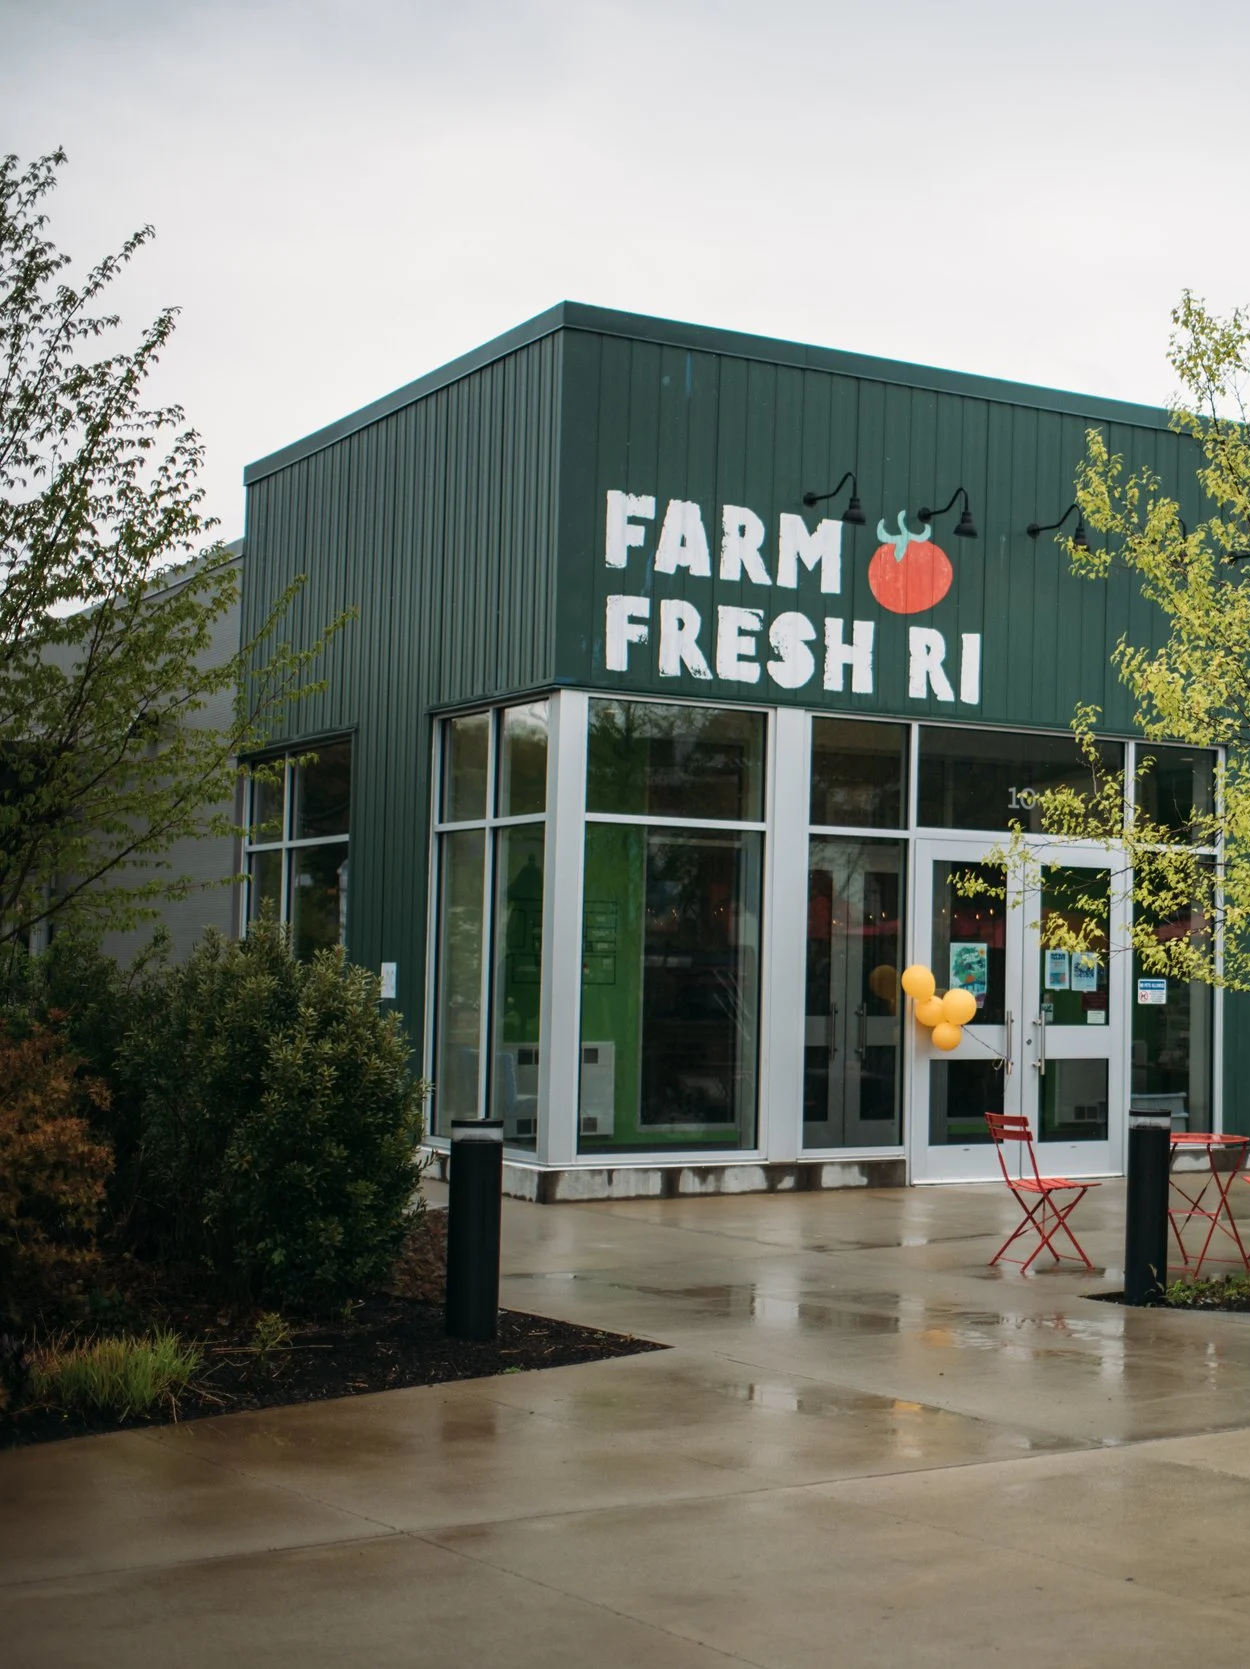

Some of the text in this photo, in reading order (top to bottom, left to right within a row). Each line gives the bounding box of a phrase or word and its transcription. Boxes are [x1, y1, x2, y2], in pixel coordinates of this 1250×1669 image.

[605, 490, 843, 594] FARM
[605, 595, 980, 705] FRESH RI
[1008, 787, 1036, 810] 10
